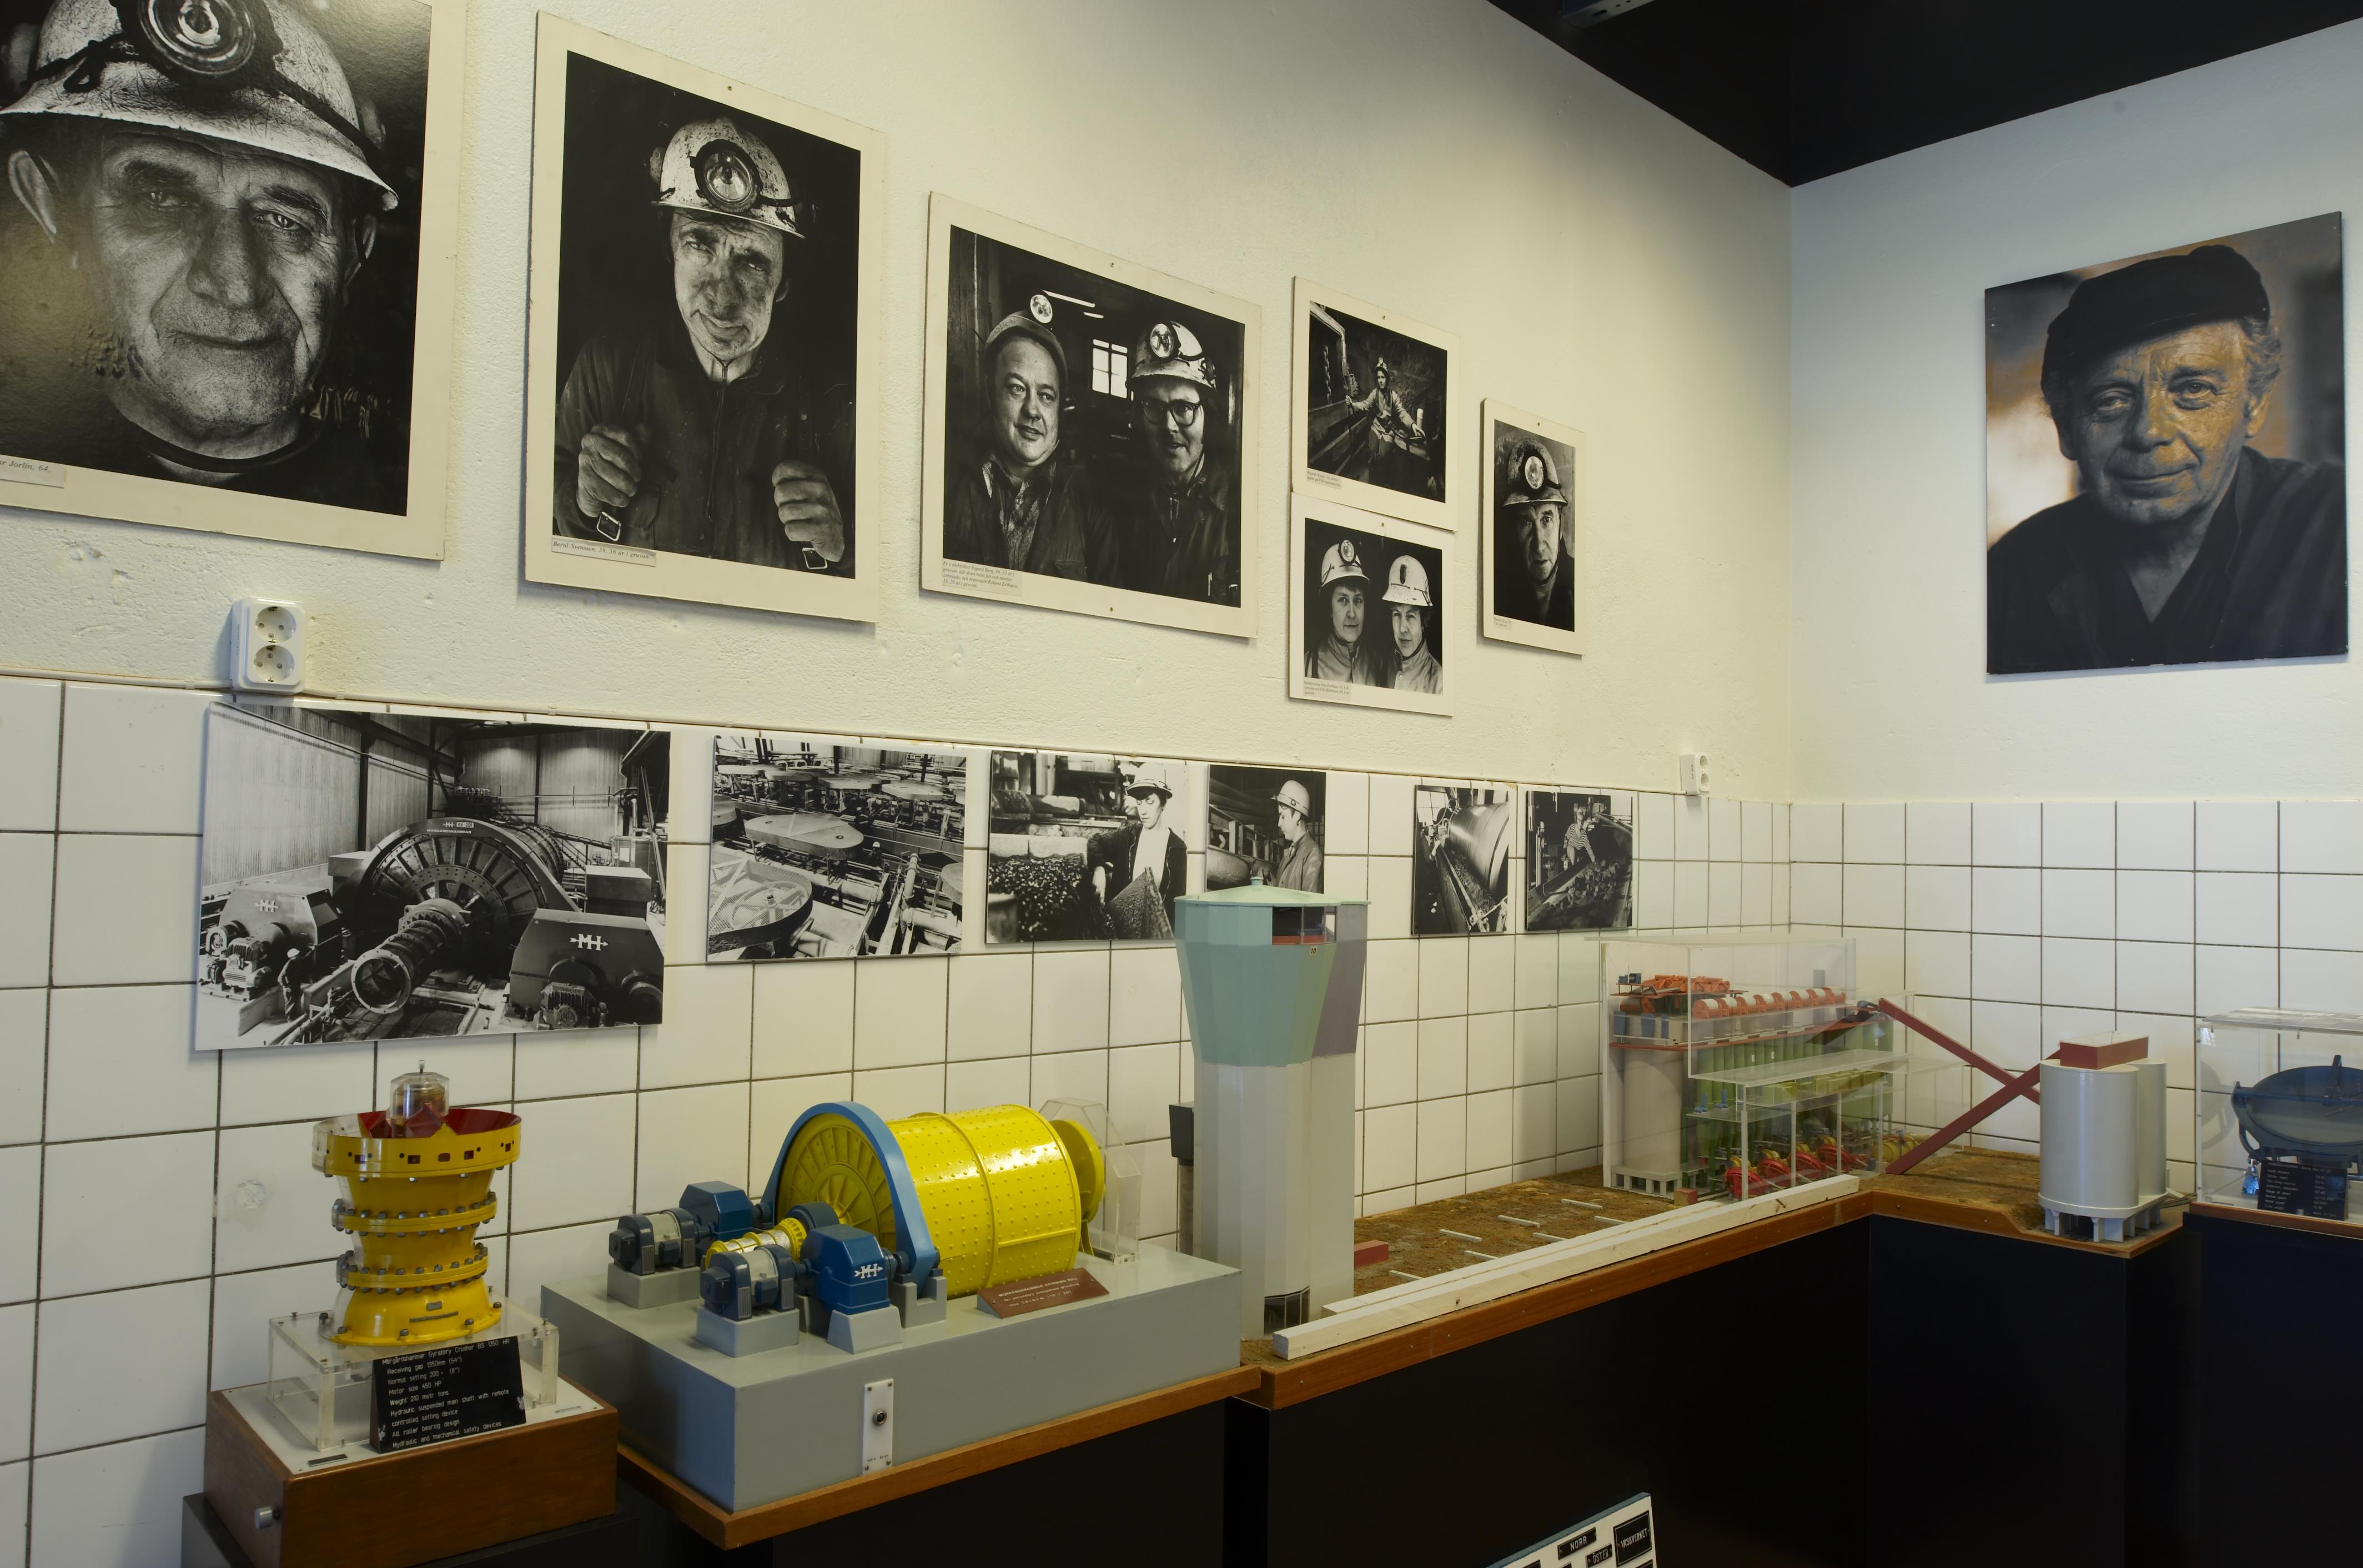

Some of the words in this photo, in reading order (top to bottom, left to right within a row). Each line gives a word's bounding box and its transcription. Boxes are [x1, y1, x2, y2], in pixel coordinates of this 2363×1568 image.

[428, 1349, 451, 1358] Gyratory
[455, 1345, 474, 1353] Crusher
[387, 1366, 412, 1375] Receiving
[409, 1373, 427, 1382] setting
[391, 1408, 415, 1417] Hydraulic
[419, 1401, 444, 1412] suspended
[392, 1417, 419, 1427] controlled
[422, 1413, 439, 1421] setting
[422, 1423, 441, 1432] bearing
[444, 1419, 460, 1428] design
[393, 1439, 418, 1449] Hydraulic
[433, 1430, 460, 1440] mechanical
[1570, 1536, 1587, 1551] NORR
[1621, 1528, 1647, 1549] VASKVERKET
[1593, 1549, 1608, 1564] ÖSTER
